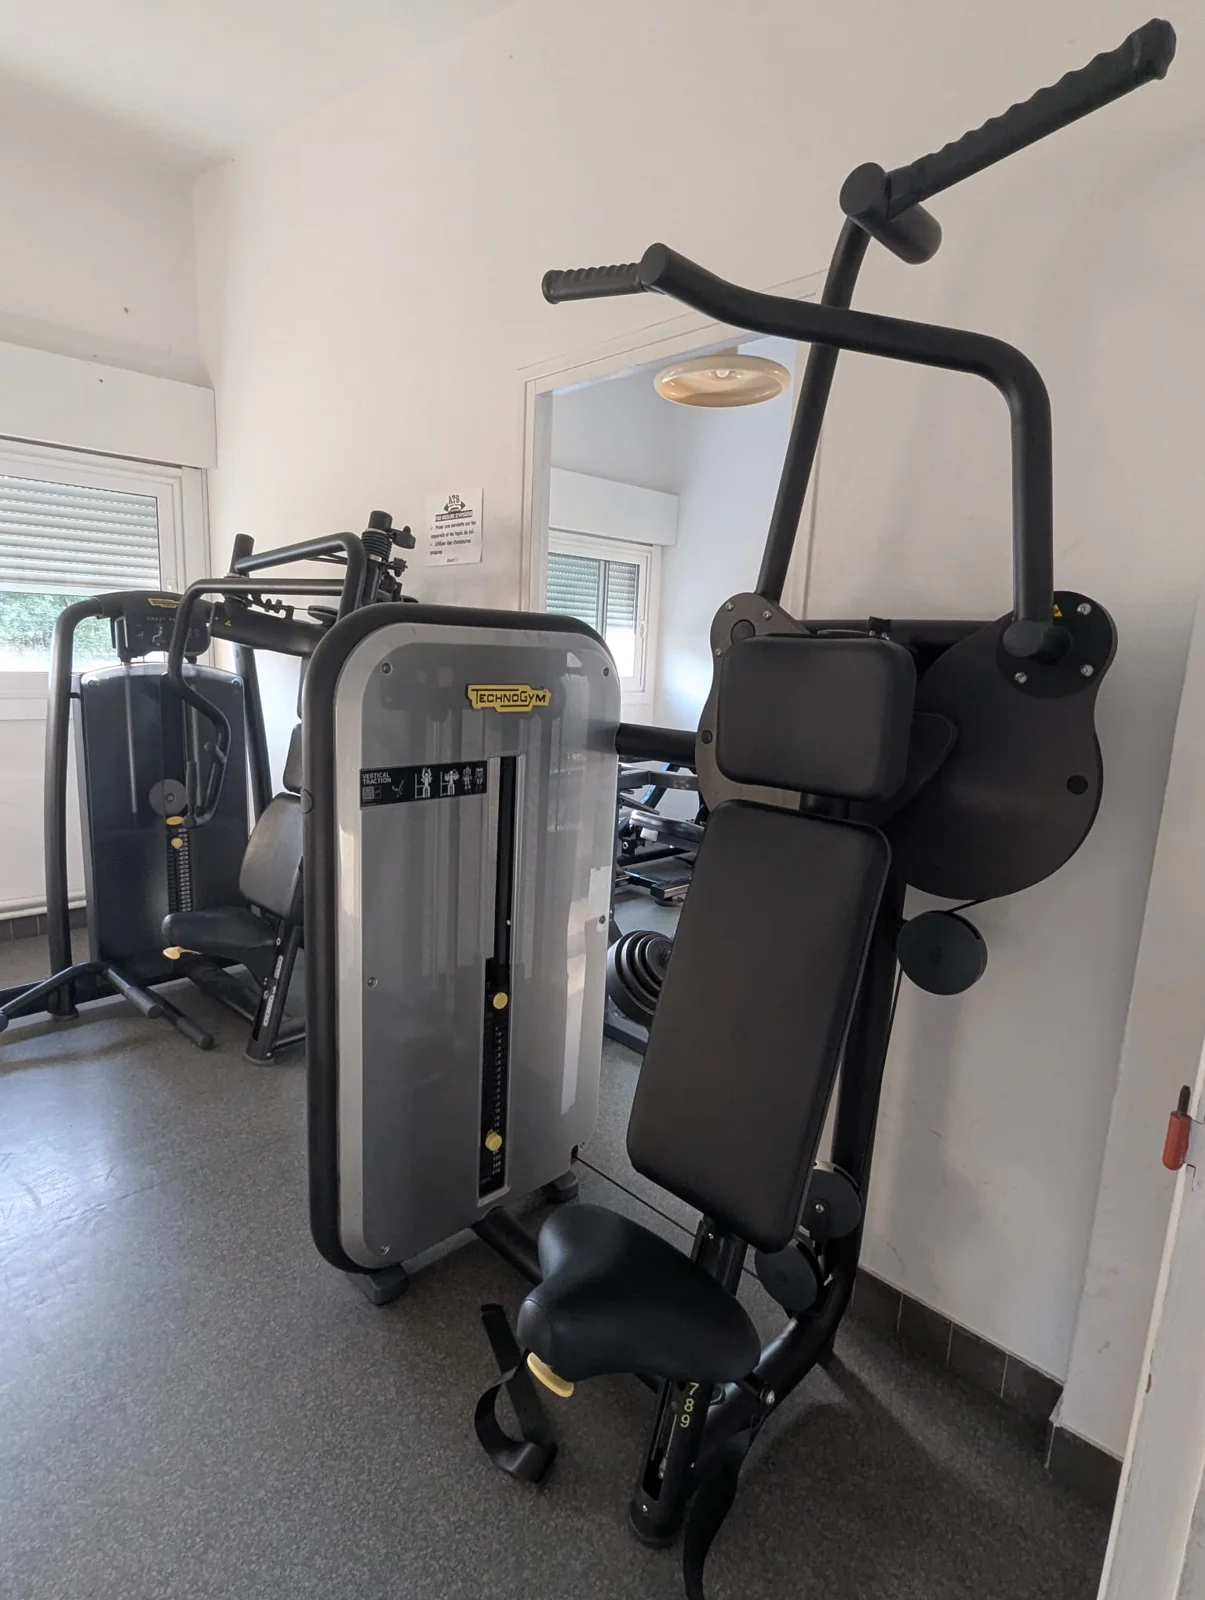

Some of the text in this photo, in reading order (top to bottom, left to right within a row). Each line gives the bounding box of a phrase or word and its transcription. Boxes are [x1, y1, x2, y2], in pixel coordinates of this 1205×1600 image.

[449, 495, 460, 504] ATS
[471, 689, 546, 707] TECHNOGYM
[690, 1382, 699, 1395] 7
[684, 1398, 694, 1412] 8
[680, 1414, 690, 1428] 9
